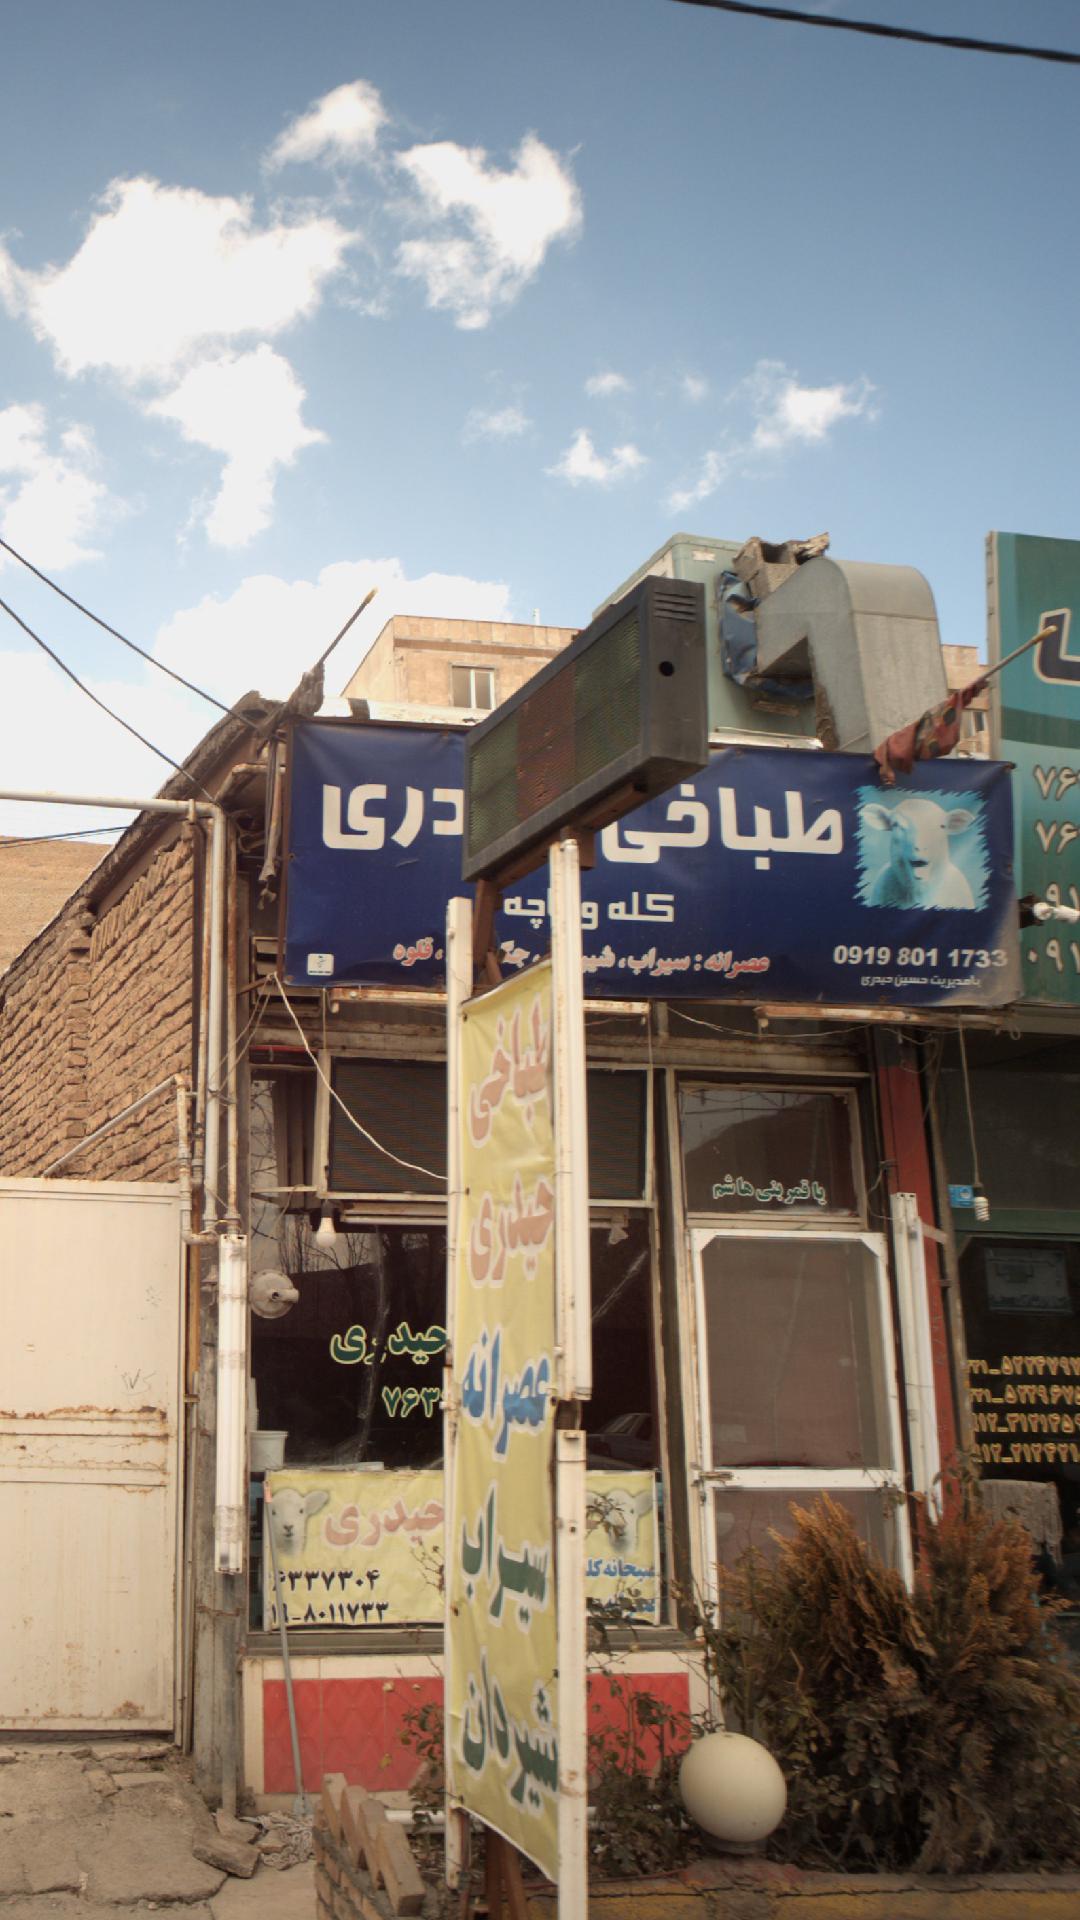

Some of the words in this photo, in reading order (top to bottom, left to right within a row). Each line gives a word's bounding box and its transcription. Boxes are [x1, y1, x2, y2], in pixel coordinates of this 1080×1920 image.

[1033, 764, 1080, 801] ۷۶
[322, 783, 464, 851] دری
[600, 784, 843, 870] طباخی
[1034, 819, 1080, 855] ۷۶
[503, 888, 553, 930] اچه
[580, 900, 599, 931] و
[608, 891, 675, 923] کله
[833, 945, 891, 966] 0919
[896, 947, 938, 967] 801
[947, 948, 1008, 969] 1733
[860, 975, 893, 987] حیدری
[894, 974, 928, 988] حسین
[712, 1174, 754, 1199] هاشم
[756, 1179, 784, 1201] بنی
[784, 1179, 809, 1204] قمر
[811, 1180, 827, 1205] یا
[467, 1171, 554, 1288] حیدری
[381, 1385, 443, 1418] ۷۶۳
[461, 1324, 550, 1463] عصرانه
[322, 1497, 445, 1550] حیدری
[461, 1482, 550, 1633] سیراب
[461, 1645, 559, 1816] شیردان
